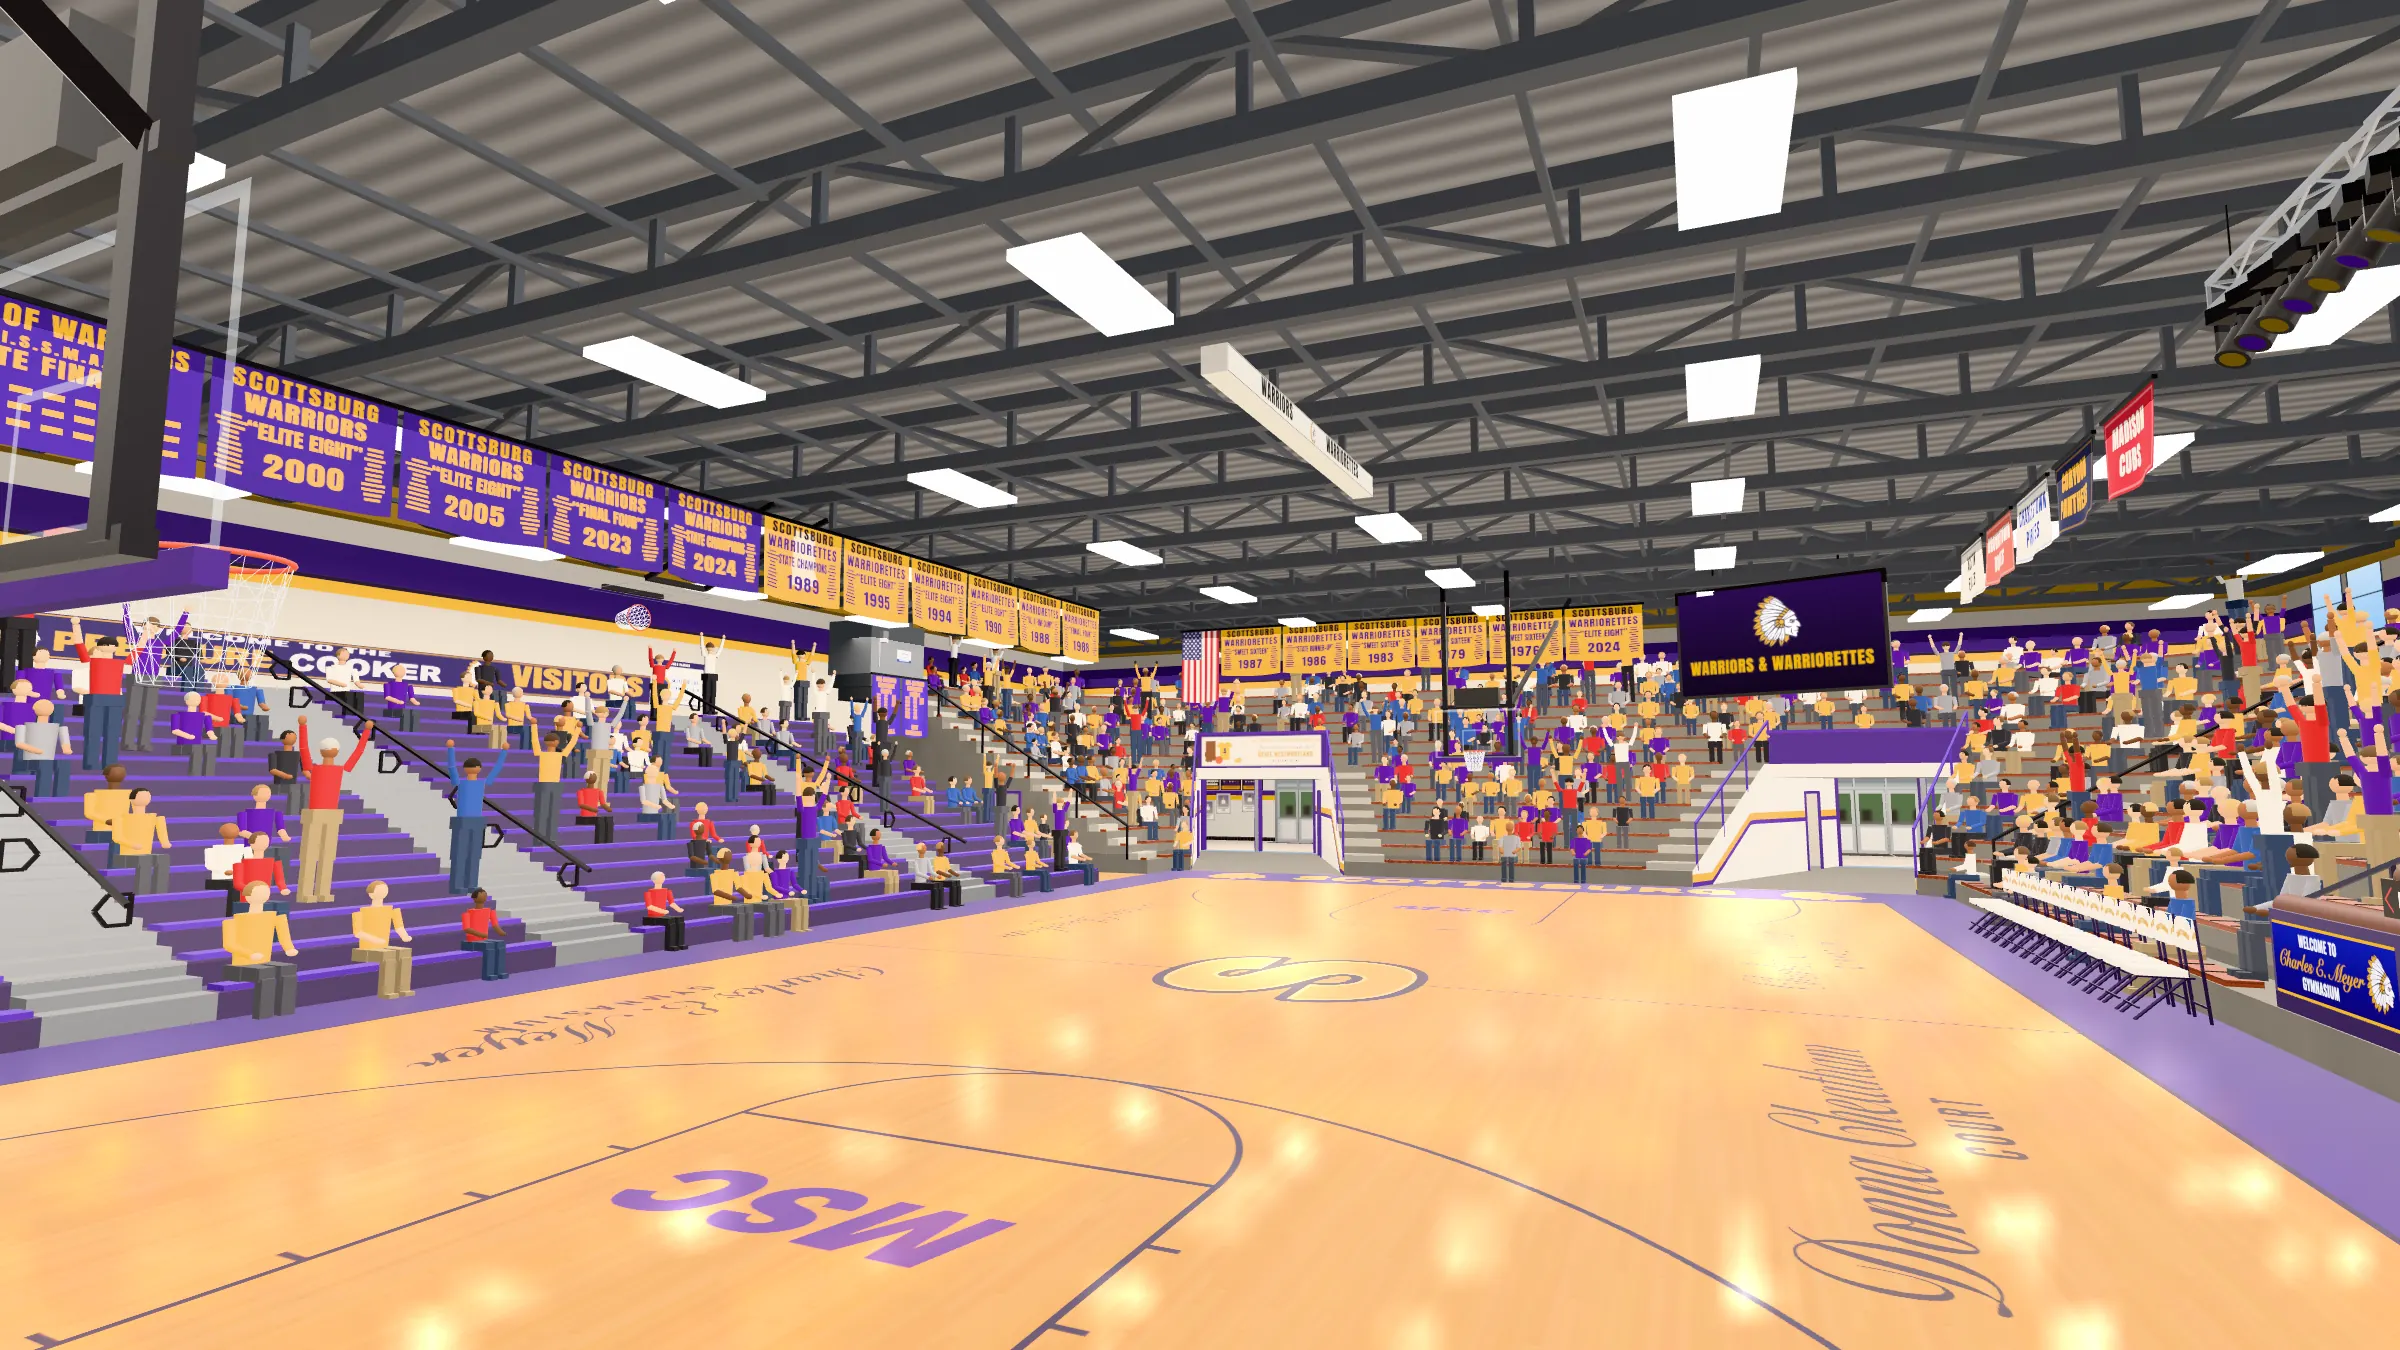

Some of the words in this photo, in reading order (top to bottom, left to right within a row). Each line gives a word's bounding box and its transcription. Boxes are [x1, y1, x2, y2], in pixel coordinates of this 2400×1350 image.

[3, 302, 40, 331] OF
[41, 355, 102, 389] FINA
[232, 366, 379, 424] SCOTTSBURG
[1261, 376, 1293, 420] WARRIORS
[244, 392, 368, 442] WARRIORS
[2112, 404, 2144, 452] MADISON
[247, 419, 304, 450] “ELITE
[308, 435, 363, 461] EIGHT”
[418, 418, 533, 465] SCOTTSBURG
[428, 440, 524, 482] WARRIORS
[2119, 442, 2142, 478] CUBS
[262, 453, 344, 492] 2000
[562, 459, 654, 499] SCOTTSBURG
[570, 479, 647, 514] WARRIORS
[444, 494, 505, 527] 2005
[678, 492, 753, 526] SCOTTSBURG
[684, 509, 747, 540] WARRIORS
[773, 520, 834, 547] SCOTTSBURG
[582, 526, 632, 555] 2023
[768, 533, 837, 562] WARRIORETTES
[693, 552, 737, 578] 2024
[850, 542, 903, 566] SCOTTSBURG
[847, 554, 906, 580] WARRIORETTES
[917, 561, 962, 582] SCOTTSBURG
[787, 574, 819, 595] 1989
[914, 572, 965, 595] WARRIORETTES
[973, 577, 1013, 596] SCOTTSBURG
[864, 591, 890, 611] 1995
[970, 588, 1015, 608] WARRIORETTES
[1022, 591, 1057, 608] SCOTTSBURG
[928, 606, 952, 624] 1994
[1021, 602, 1059, 620] WARRIORETTES
[1065, 603, 1096, 619] SCOTTSBURG
[1423, 615, 1479, 626] SCOTSBURG
[1569, 616, 1638, 628] WARRIORETTES
[1572, 606, 1634, 618] SCOTTSBURG
[985, 619, 1002, 635] 1990
[1226, 628, 1275, 638] SCOTTSBURG
[1289, 624, 1339, 634] SCOTTSBURG
[1351, 629, 1411, 640] WARRIORETTES
[1354, 620, 1407, 630] SCOTTSBURG
[1493, 621, 1553, 632] WARIORETTE
[1031, 630, 1050, 645] 1988
[1073, 640, 1090, 653] 1988
[1224, 636, 1278, 647] WARRIORETTES
[1286, 632, 1343, 644] WARRIORETTES
[1587, 642, 1620, 653] 2024
[298, 642, 334, 652] TO
[347, 647, 392, 658] THE
[1302, 655, 1327, 667] 1986
[1368, 652, 1394, 663] 1983
[1438, 649, 1466, 660] 179
[1238, 658, 1263, 669] 1987
[1690, 657, 1755, 677] WARRIORS
[1758, 656, 1768, 672] &
[1772, 648, 1875, 671] WARRIORETTES
[512, 664, 643, 698] VISITOS
[1293, 875, 1736, 896] SCOTTSBURG
[2297, 934, 2327, 954] WELCOME
[2327, 941, 2337, 958] TO
[2280, 948, 2314, 974] Charles
[2315, 958, 2327, 979] E.
[2328, 963, 2366, 993] Meyer
[2302, 976, 2341, 1002] GYMNASIUM
[1929, 1097, 2029, 1160] COURT
[611, 1169, 1017, 1268] MSC
[1788, 1154, 2013, 1318] Donna
